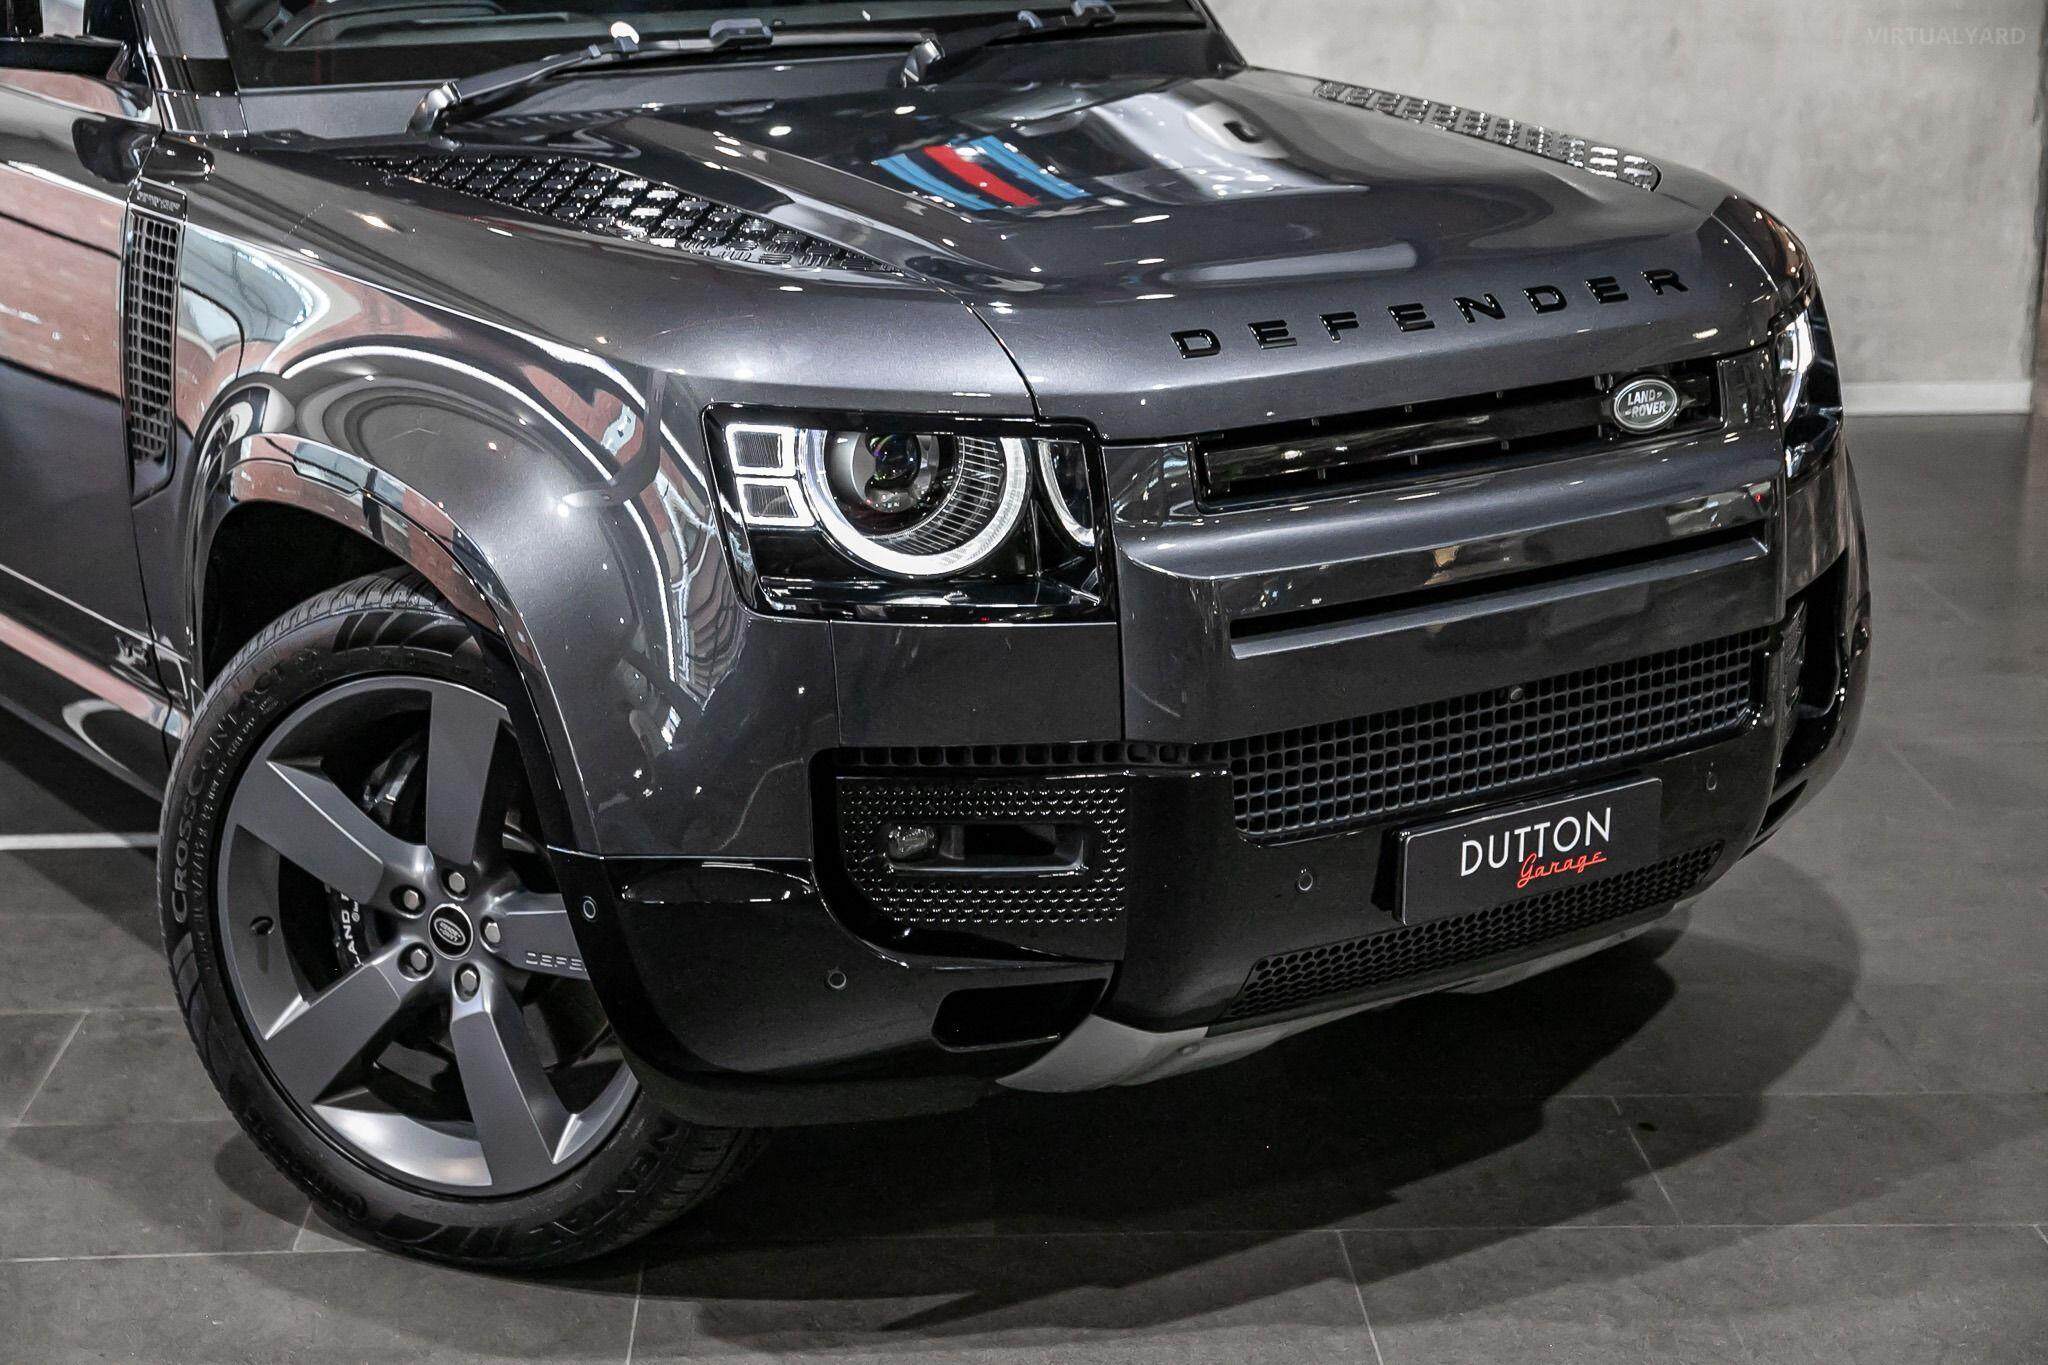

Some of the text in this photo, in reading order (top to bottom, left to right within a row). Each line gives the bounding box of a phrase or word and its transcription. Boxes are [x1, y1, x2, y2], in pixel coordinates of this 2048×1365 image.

[1170, 268, 1688, 360] DEFENDER
[1627, 388, 1656, 406] LAND
[1631, 400, 1667, 418] ROVER
[1460, 807, 1612, 877] DUTTON
[1517, 851, 1608, 889] Garage
[526, 952, 588, 972] DEFE
